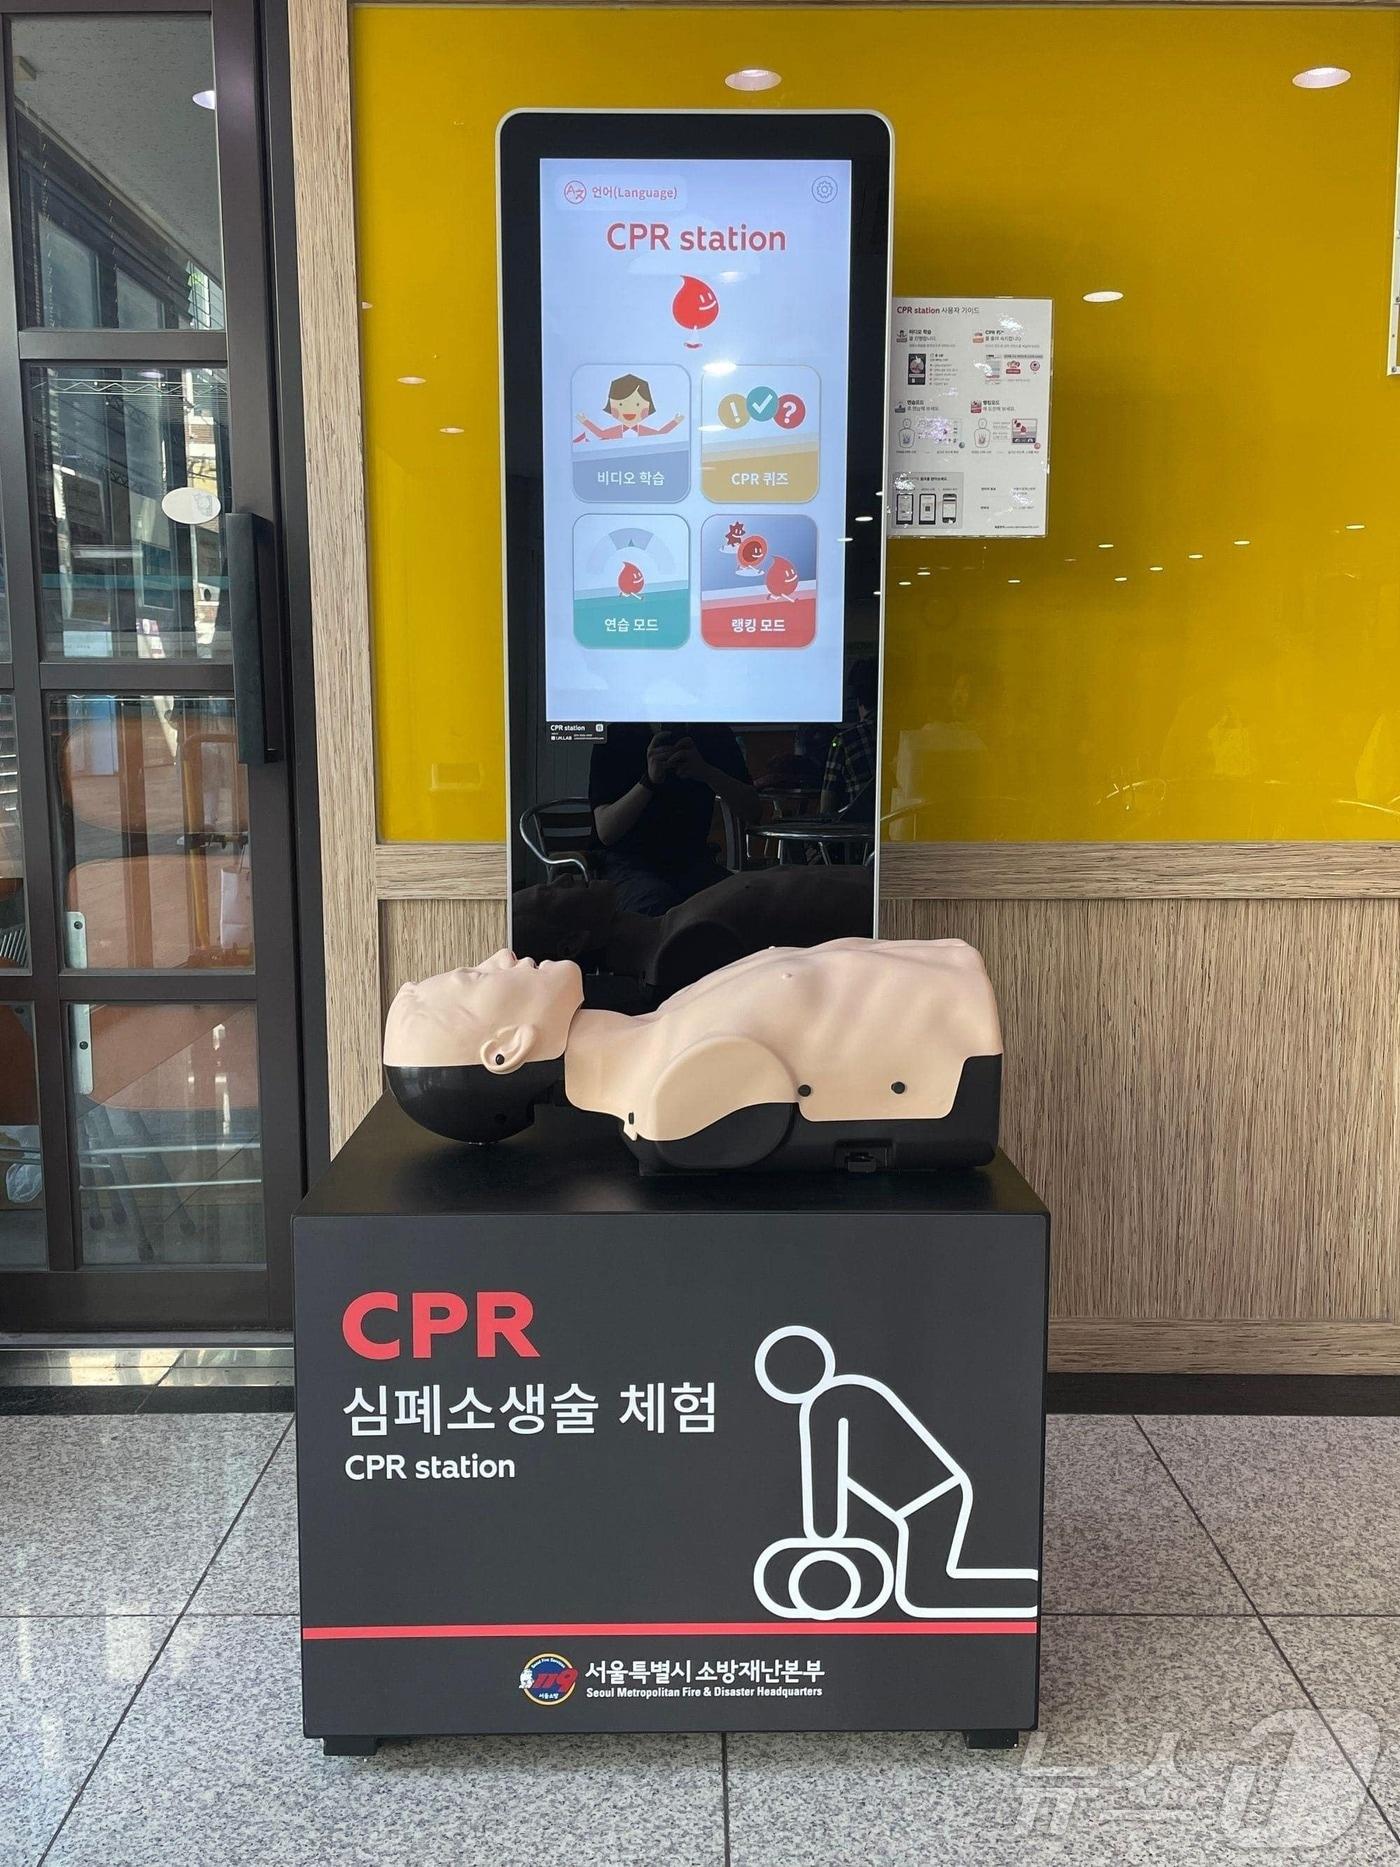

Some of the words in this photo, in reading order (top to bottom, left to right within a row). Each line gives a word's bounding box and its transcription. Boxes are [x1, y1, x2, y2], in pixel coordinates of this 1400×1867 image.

[591, 186, 679, 201] 언어(Language)
[606, 222, 672, 252] CPR
[679, 223, 787, 252] station
[896, 306, 913, 315] CPR
[914, 306, 941, 315] station
[597, 470, 637, 487] 비디오
[639, 470, 666, 487] 학습
[731, 472, 760, 487] CPR
[763, 471, 789, 487] 퀴즈
[603, 617, 630, 633] 연습
[633, 618, 660, 632] 모드
[731, 617, 758, 633] 랭킹
[760, 618, 786, 633] 모드
[341, 1290, 541, 1361] CPR
[342, 1383, 599, 1437] 심폐소생술
[618, 1381, 716, 1435] 체험
[344, 1454, 408, 1481] CPR
[414, 1453, 516, 1480] station
[584, 1659, 692, 1685] 서울특별시
[694, 1659, 826, 1685] 소방재난본부
[586, 1686, 616, 1699] Seoul
[616, 1686, 681, 1700] Metropolitan
[681, 1686, 702, 1698] Fire
[703, 1686, 713, 1698] &
[714, 1686, 755, 1698] Disaster
[756, 1686, 823, 1699] Headquarters
